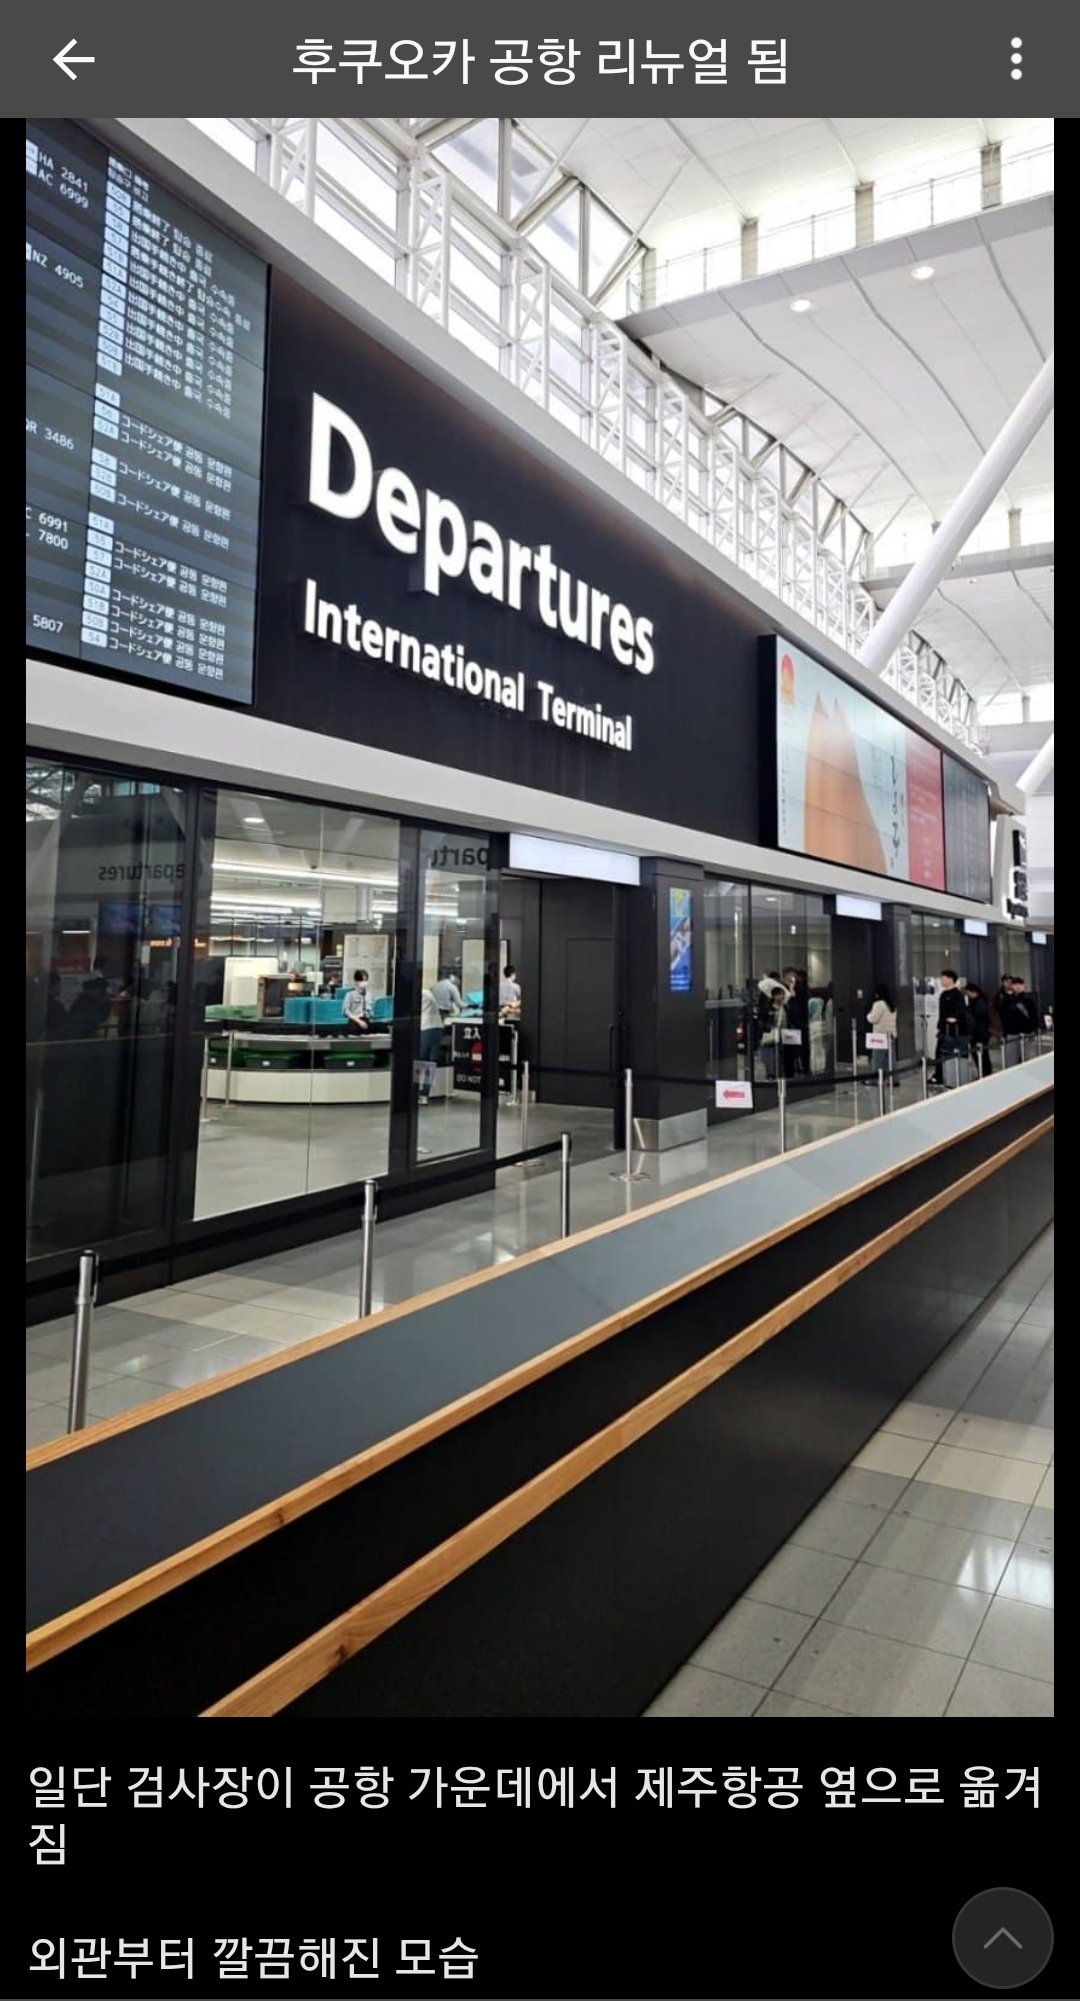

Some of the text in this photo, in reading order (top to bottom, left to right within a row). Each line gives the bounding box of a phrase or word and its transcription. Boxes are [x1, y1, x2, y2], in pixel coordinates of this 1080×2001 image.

[38, 169, 90, 209] AC 6999
[32, 250, 85, 290] NZ 4905
[45, 428, 74, 450] 3486
[38, 512, 68, 533] 6991
[38, 529, 69, 550] 7800
[309, 392, 654, 674] Departures
[32, 614, 64, 634] 5807
[304, 578, 524, 712] International
[538, 681, 632, 751] Terminal
